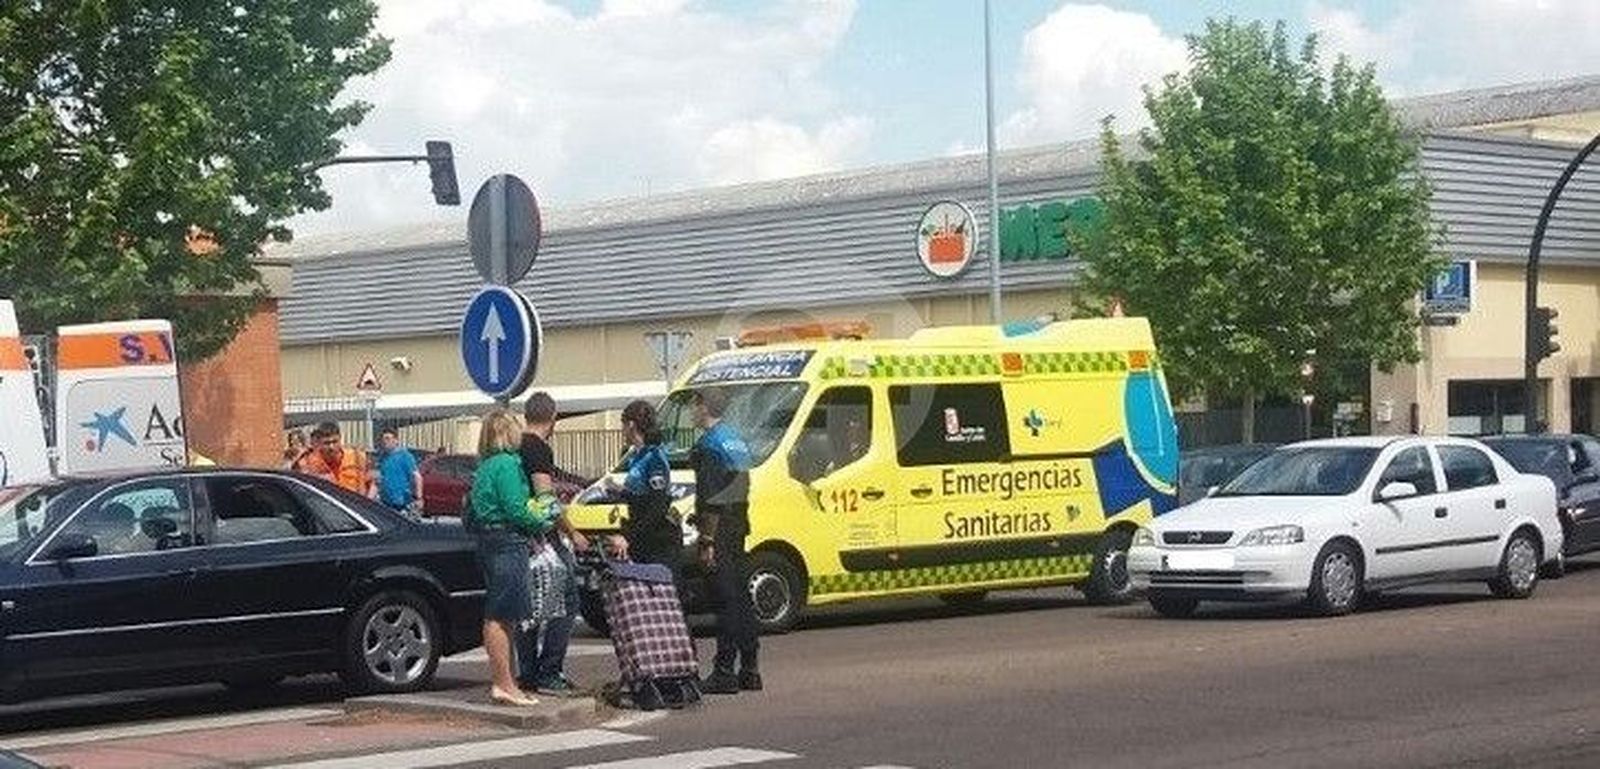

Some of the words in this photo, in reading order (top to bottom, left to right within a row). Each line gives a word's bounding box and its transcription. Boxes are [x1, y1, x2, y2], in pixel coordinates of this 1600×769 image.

[942, 462, 1082, 500] Emergencias
[831, 488, 859, 513] 112
[944, 507, 1052, 538] Sanitarias
